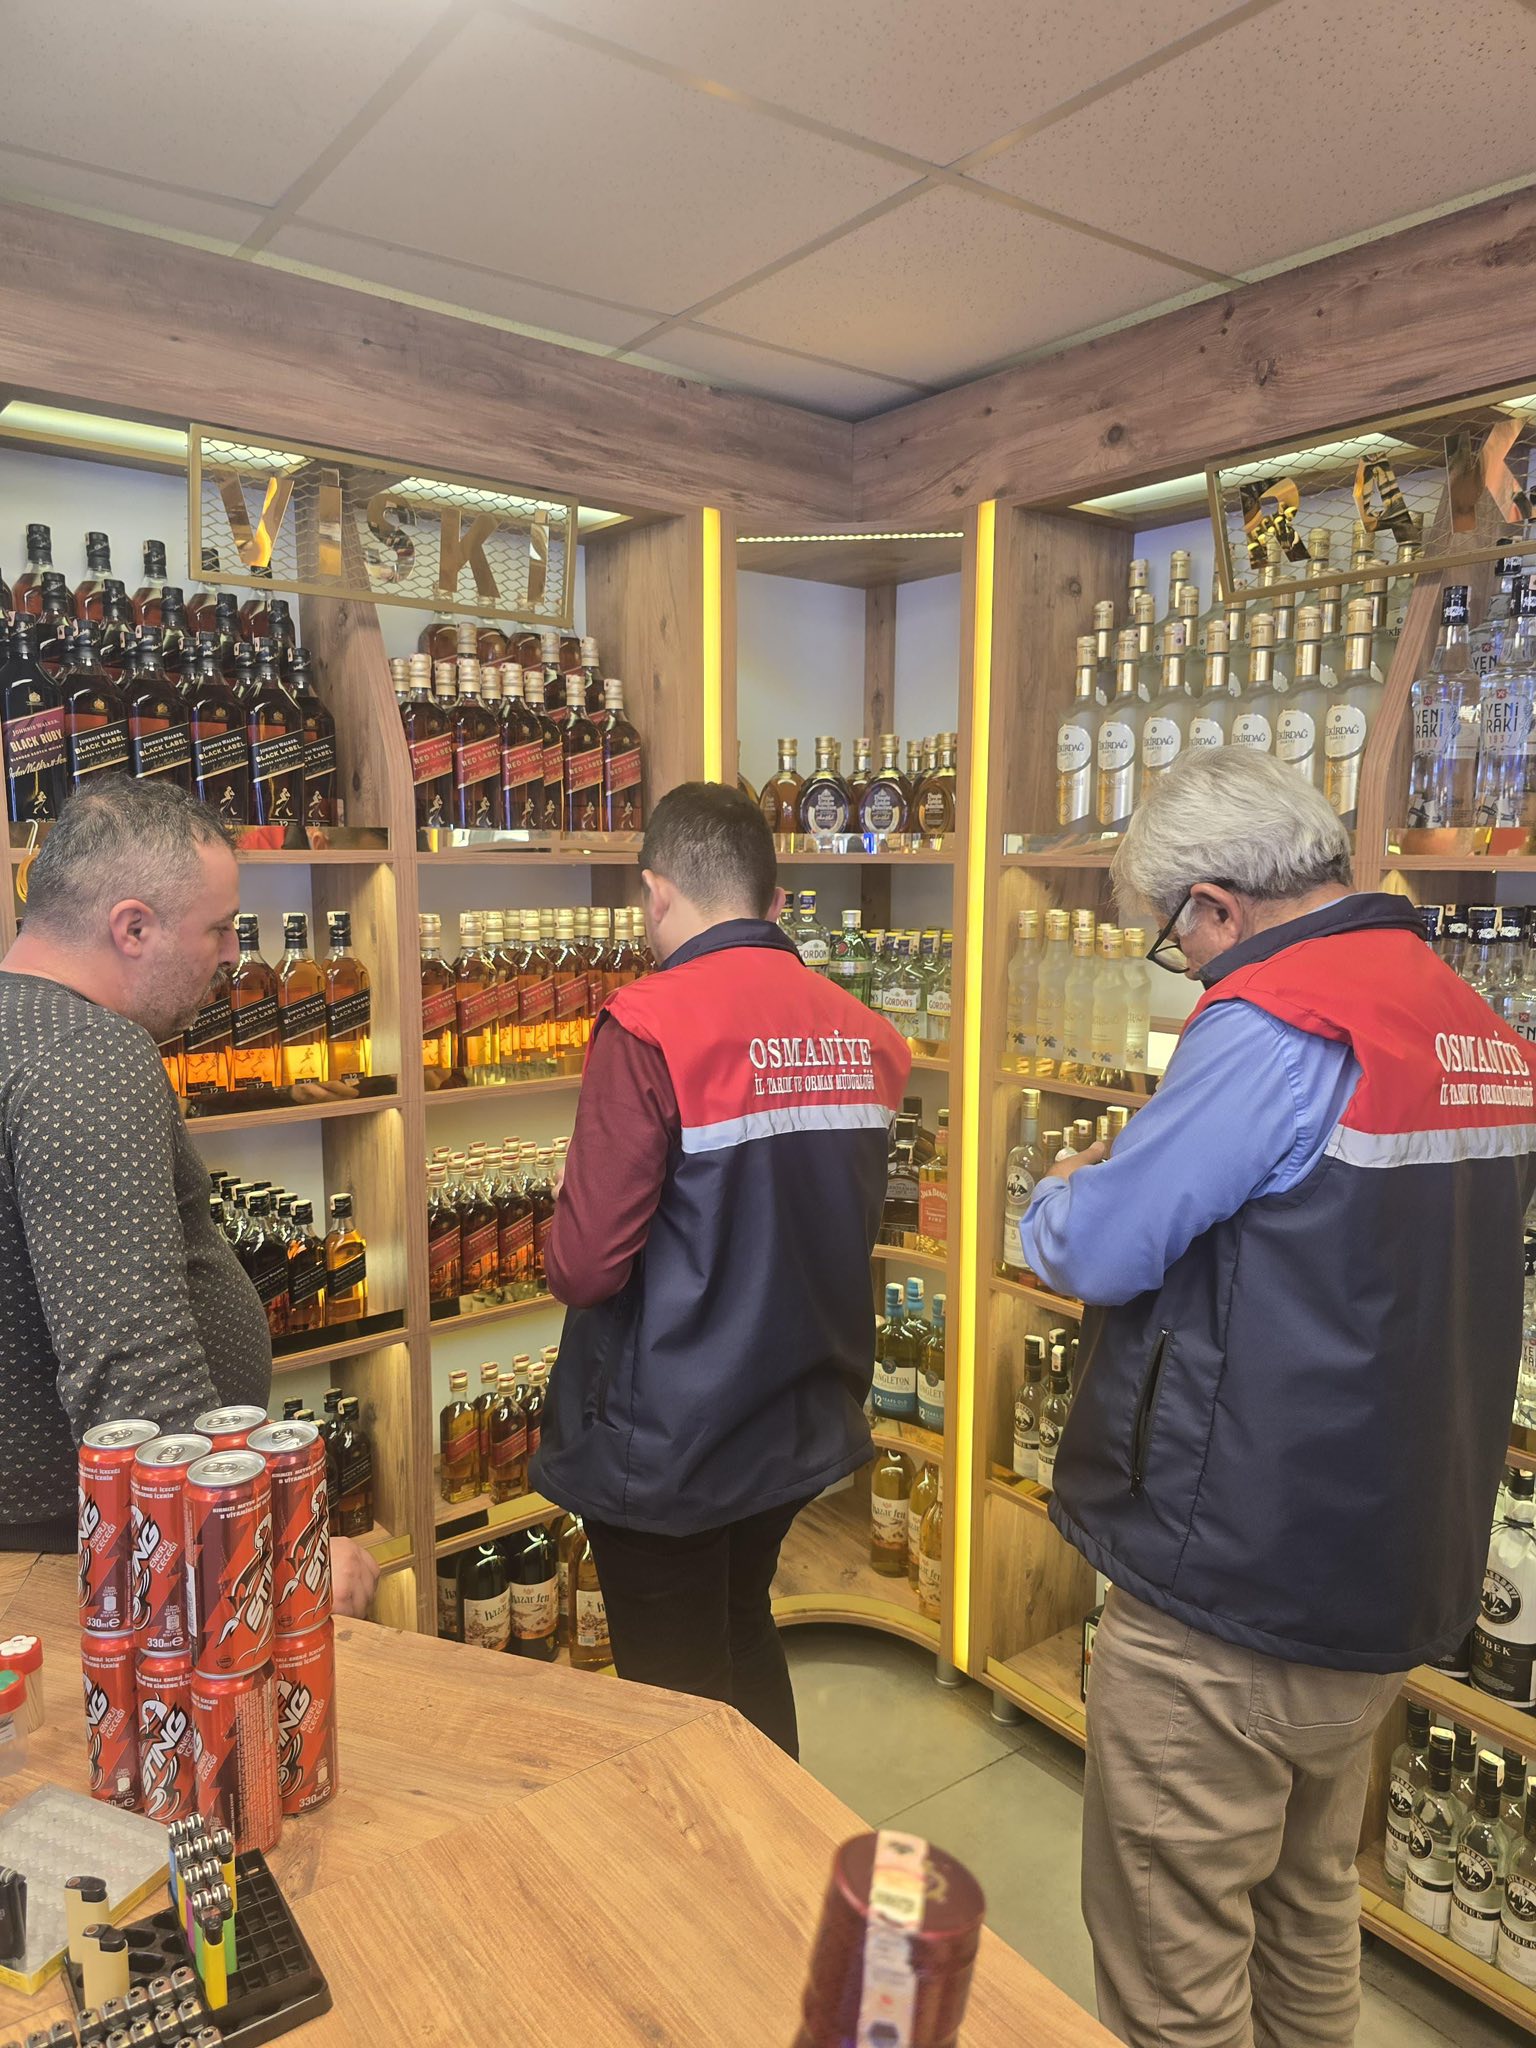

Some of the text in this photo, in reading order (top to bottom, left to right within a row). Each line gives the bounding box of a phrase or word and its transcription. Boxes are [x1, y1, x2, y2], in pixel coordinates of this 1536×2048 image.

[9, 729, 63, 753] BLACK RUBY
[75, 742, 100, 755] BLACK
[139, 745, 164, 757] BLACK
[198, 748, 222, 760] BLACK
[256, 751, 279, 763] BLACK
[749, 1029, 872, 1069] OSMANİYE
[1435, 1030, 1530, 1076] OSMANİYE
[754, 1073, 765, 1095] İL
[805, 1074, 834, 1092] ORMAN
[143, 1708, 188, 1797] STING
